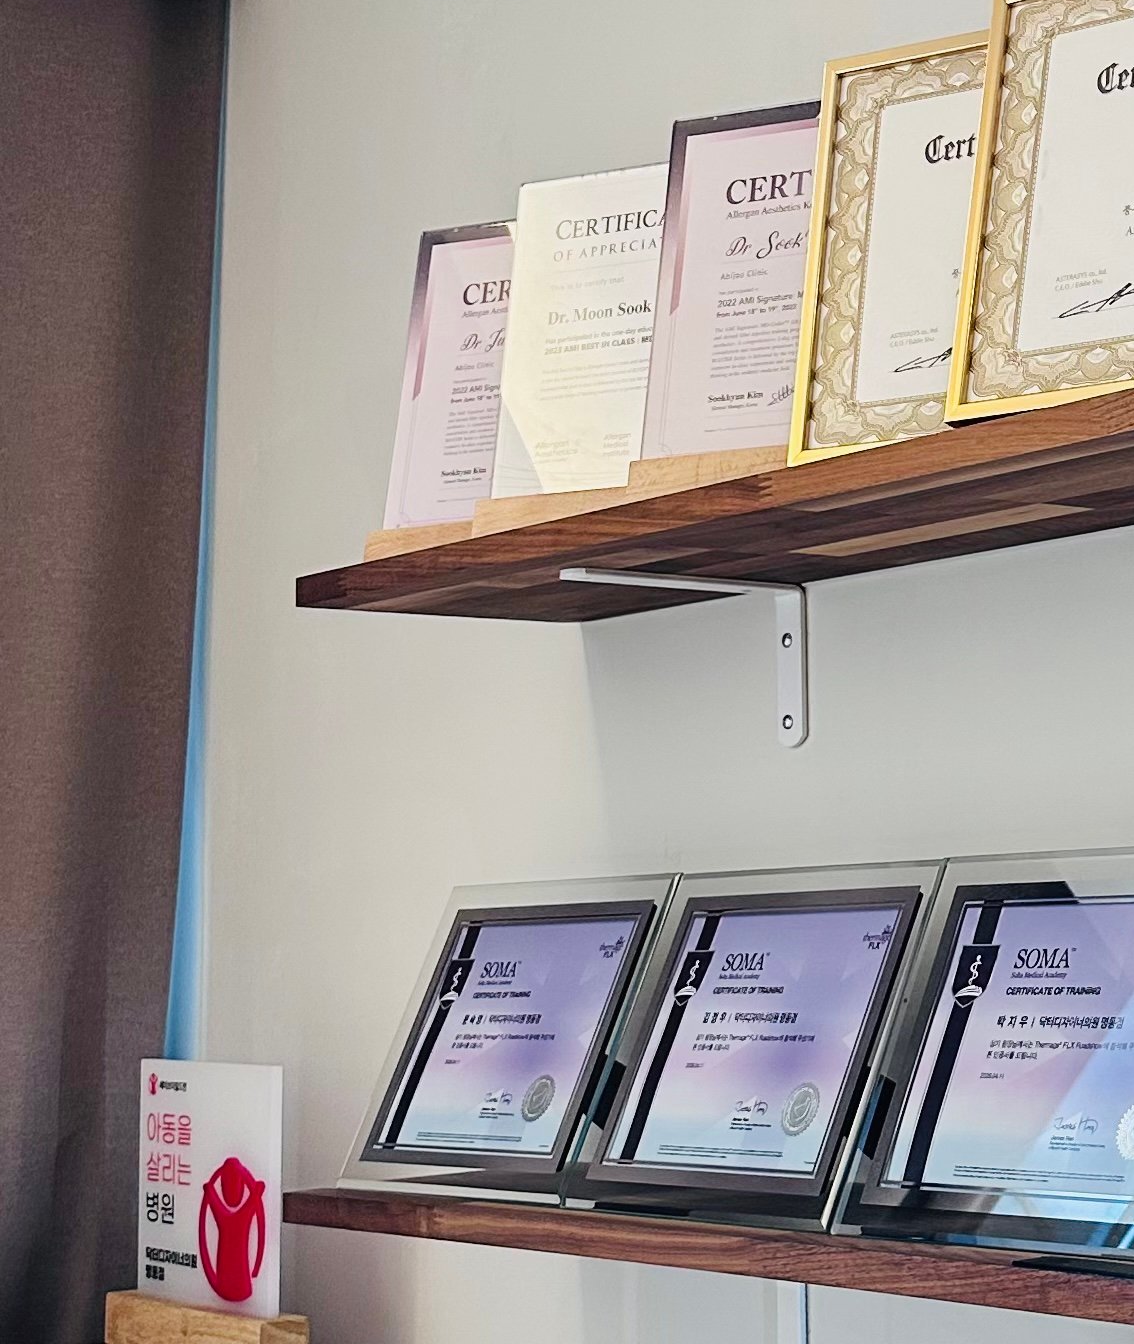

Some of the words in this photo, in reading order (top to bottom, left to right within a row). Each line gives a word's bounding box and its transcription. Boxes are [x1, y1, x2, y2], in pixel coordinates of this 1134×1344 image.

[726, 209, 759, 220] Allergan
[553, 249, 574, 262] OF
[726, 236, 753, 257] Dr
[717, 299, 737, 308] 2022
[757, 294, 793, 305] Signature
[548, 311, 570, 326] Dr.
[572, 306, 613, 323] Moon
[617, 300, 652, 317] Sook
[722, 953, 765, 971] SOMA
[1013, 947, 1071, 969] SOMA
[480, 961, 517, 979] SOMA
[713, 986, 747, 995] CERTIFICATE
[757, 986, 784, 994] TRAINING
[1006, 986, 1052, 995] CERTIFICATE
[1053, 986, 1064, 995] OF
[1065, 986, 1101, 995] TRAINING
[146, 1152, 192, 1186] 살리는
[146, 1191, 175, 1224] 병원
